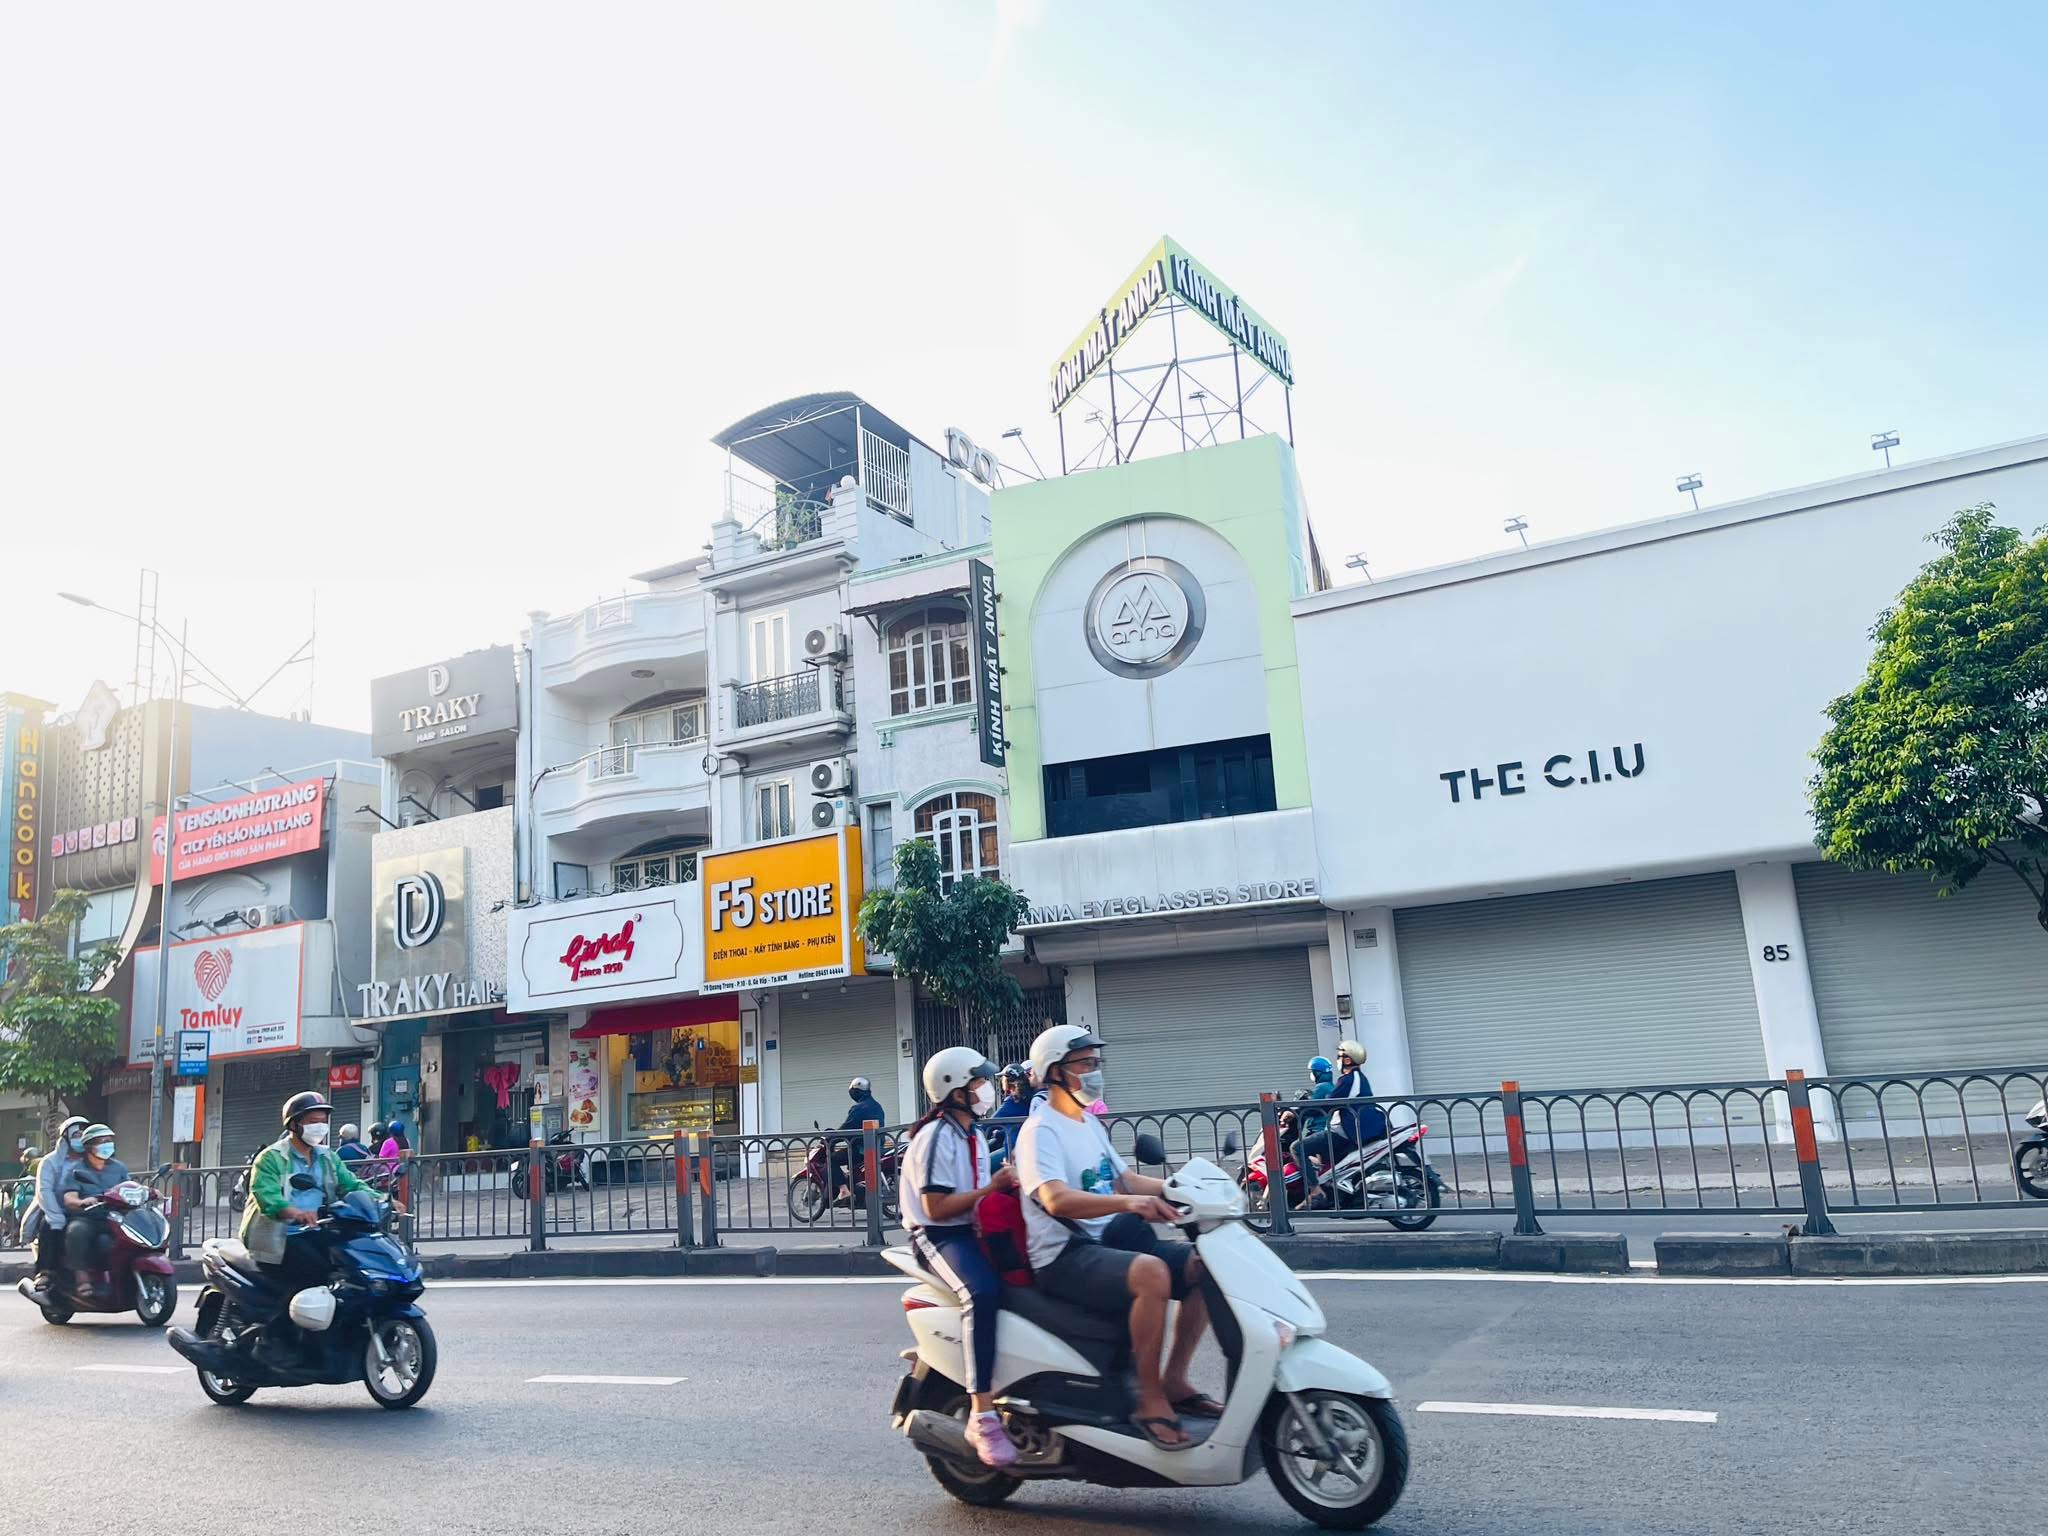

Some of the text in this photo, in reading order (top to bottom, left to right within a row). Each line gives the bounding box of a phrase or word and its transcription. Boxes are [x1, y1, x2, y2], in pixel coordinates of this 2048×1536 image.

[1048, 350, 1085, 413] KÍNH
[1118, 260, 1167, 337] ANNA
[1170, 254, 1218, 322] KÍNH
[1253, 325, 1295, 386] ANNA
[982, 574, 997, 636] ANNA
[1111, 621, 1177, 645] anna
[399, 693, 481, 732] TRAKY
[416, 724, 467, 743] HAIR SALON
[986, 699, 1003, 757] KÍNH
[1439, 742, 1646, 803] THE C.I.U
[16, 727, 39, 899] Hancook
[178, 784, 318, 832] YENSAONHATRANG
[181, 838, 206, 856] CTCP
[249, 822, 273, 840] NHA
[272, 812, 313, 836] TRANG
[711, 877, 833, 932] F5 STORE
[1017, 878, 1316, 925] ANNA EYEGLASSES STORE
[580, 962, 623, 977] since 1950
[754, 943, 767, 954] MÁY
[767, 941, 782, 952] TÍNH
[1762, 944, 1790, 962] 85
[357, 972, 498, 1018] TRAKY HAIR
